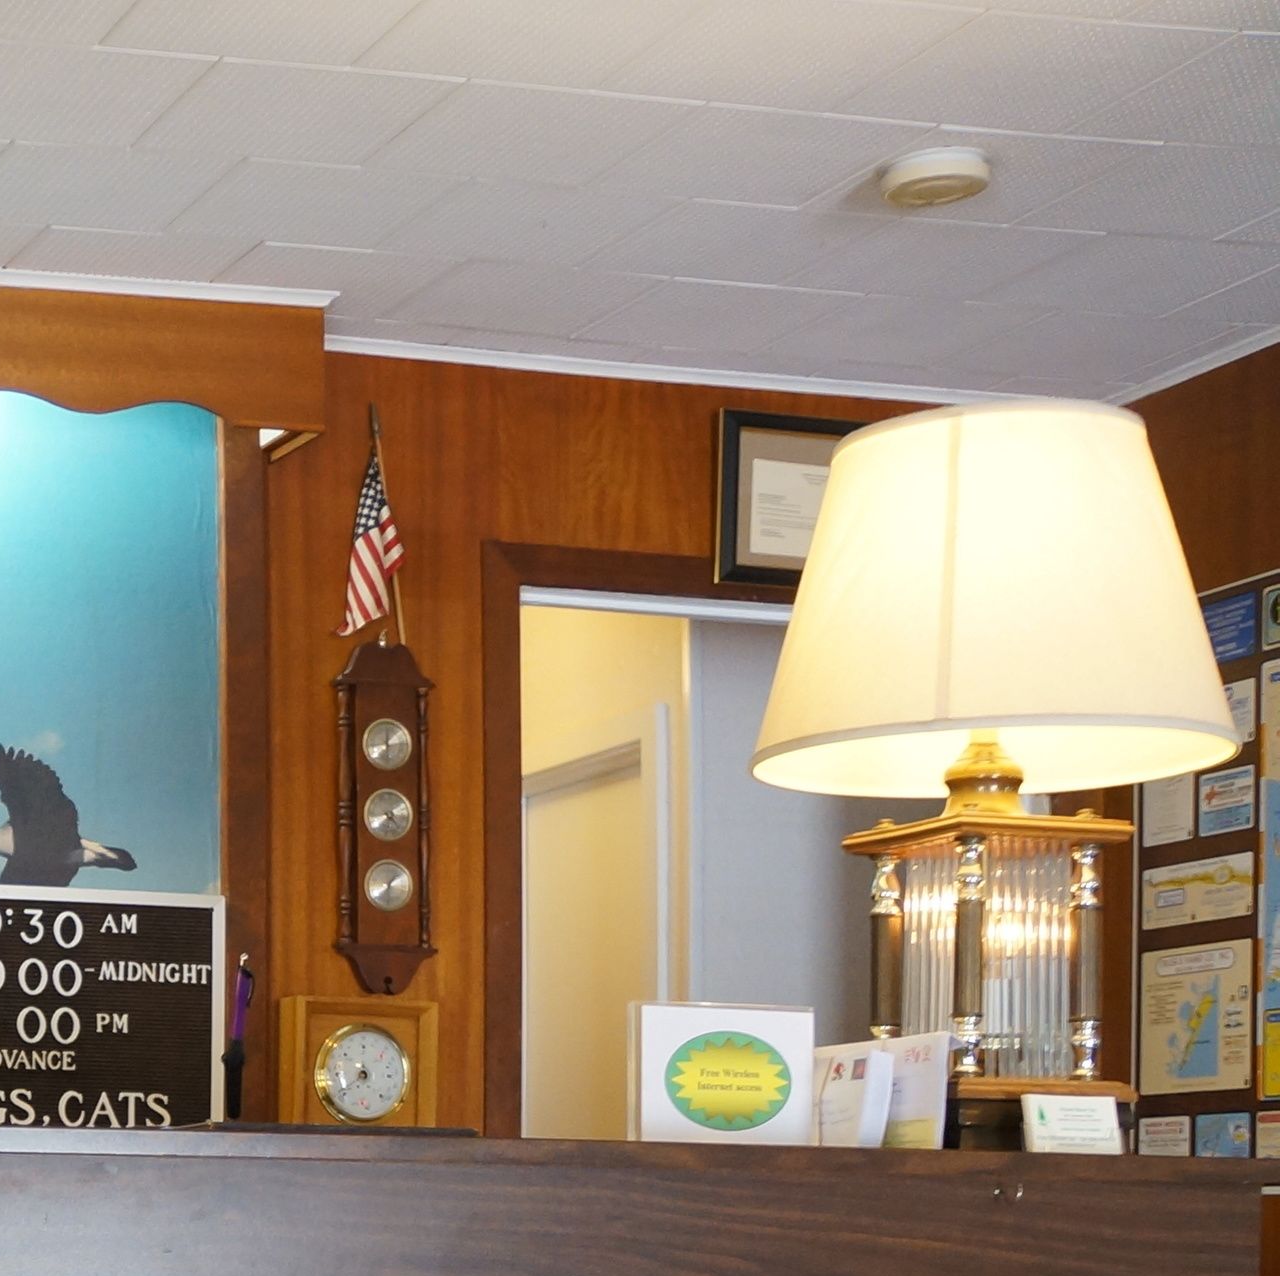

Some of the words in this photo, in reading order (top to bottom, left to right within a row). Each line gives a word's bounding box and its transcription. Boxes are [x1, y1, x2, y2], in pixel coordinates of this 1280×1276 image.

[99, 913, 138, 934] AM
[96, 1013, 129, 1034] PM
[700, 1068, 720, 1077] Free
[697, 1081, 733, 1091] Internet
